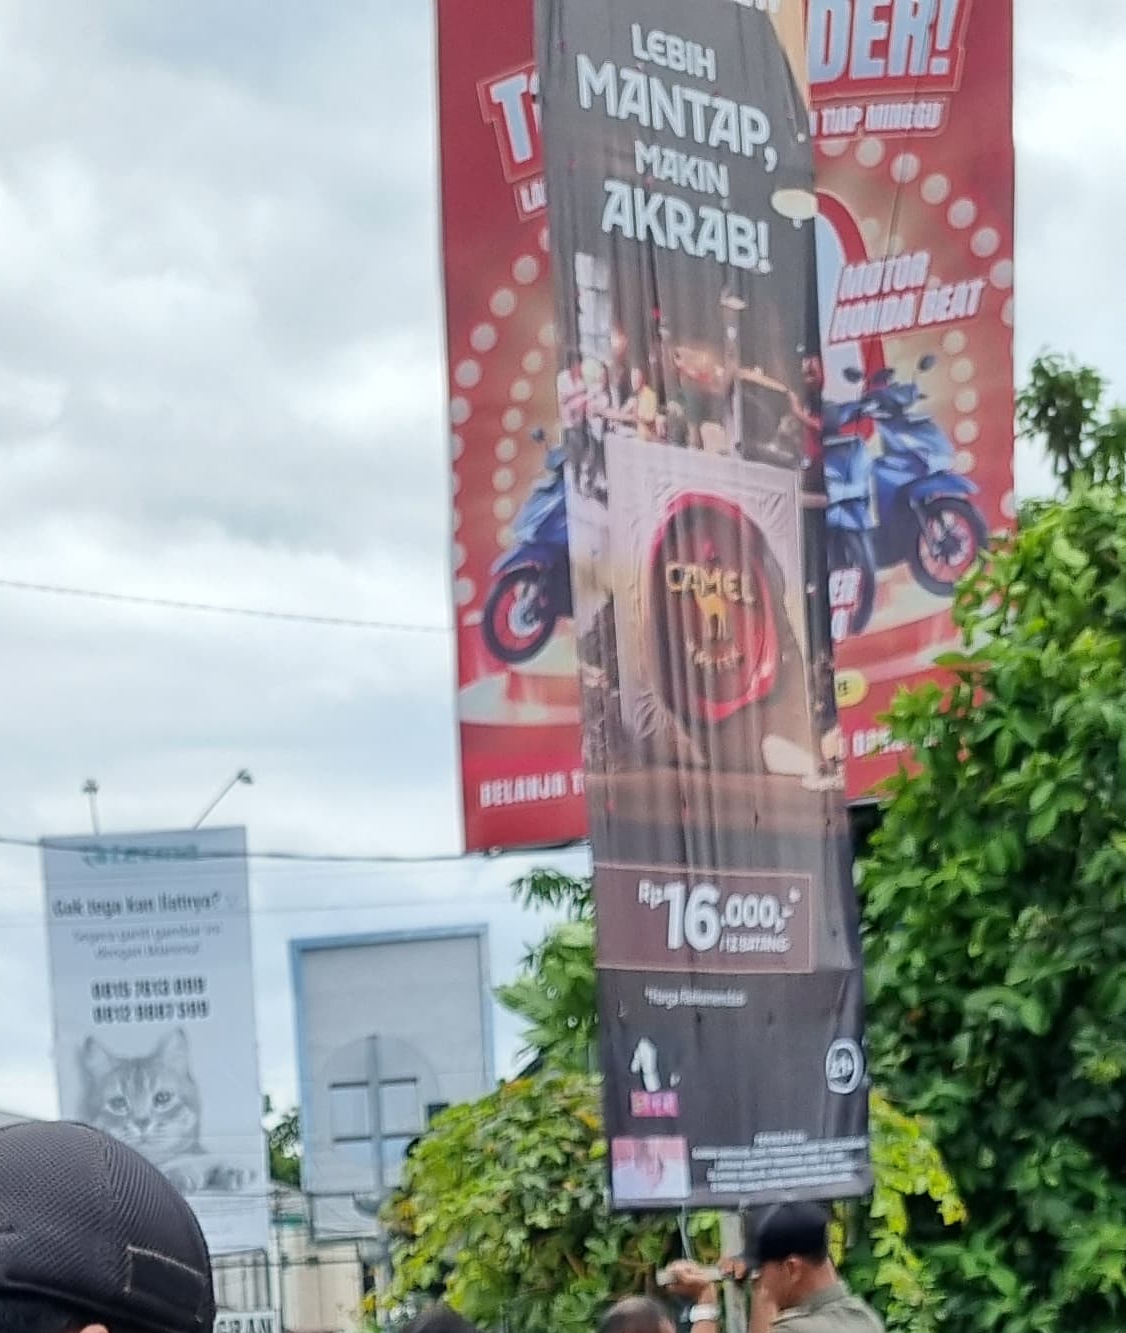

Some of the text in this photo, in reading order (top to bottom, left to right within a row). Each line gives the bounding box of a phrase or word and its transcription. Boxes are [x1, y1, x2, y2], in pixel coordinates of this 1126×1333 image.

[631, 22, 716, 82] LEBIH
[577, 53, 778, 172] MANTAP,
[635, 140, 730, 197] MAKIN
[602, 180, 771, 273] AKRAB!
[839, 251, 930, 301] MOTOR
[830, 278, 986, 341] HONDA BEAT
[665, 562, 756, 605] CAMEL
[479, 771, 567, 807] BELANJA
